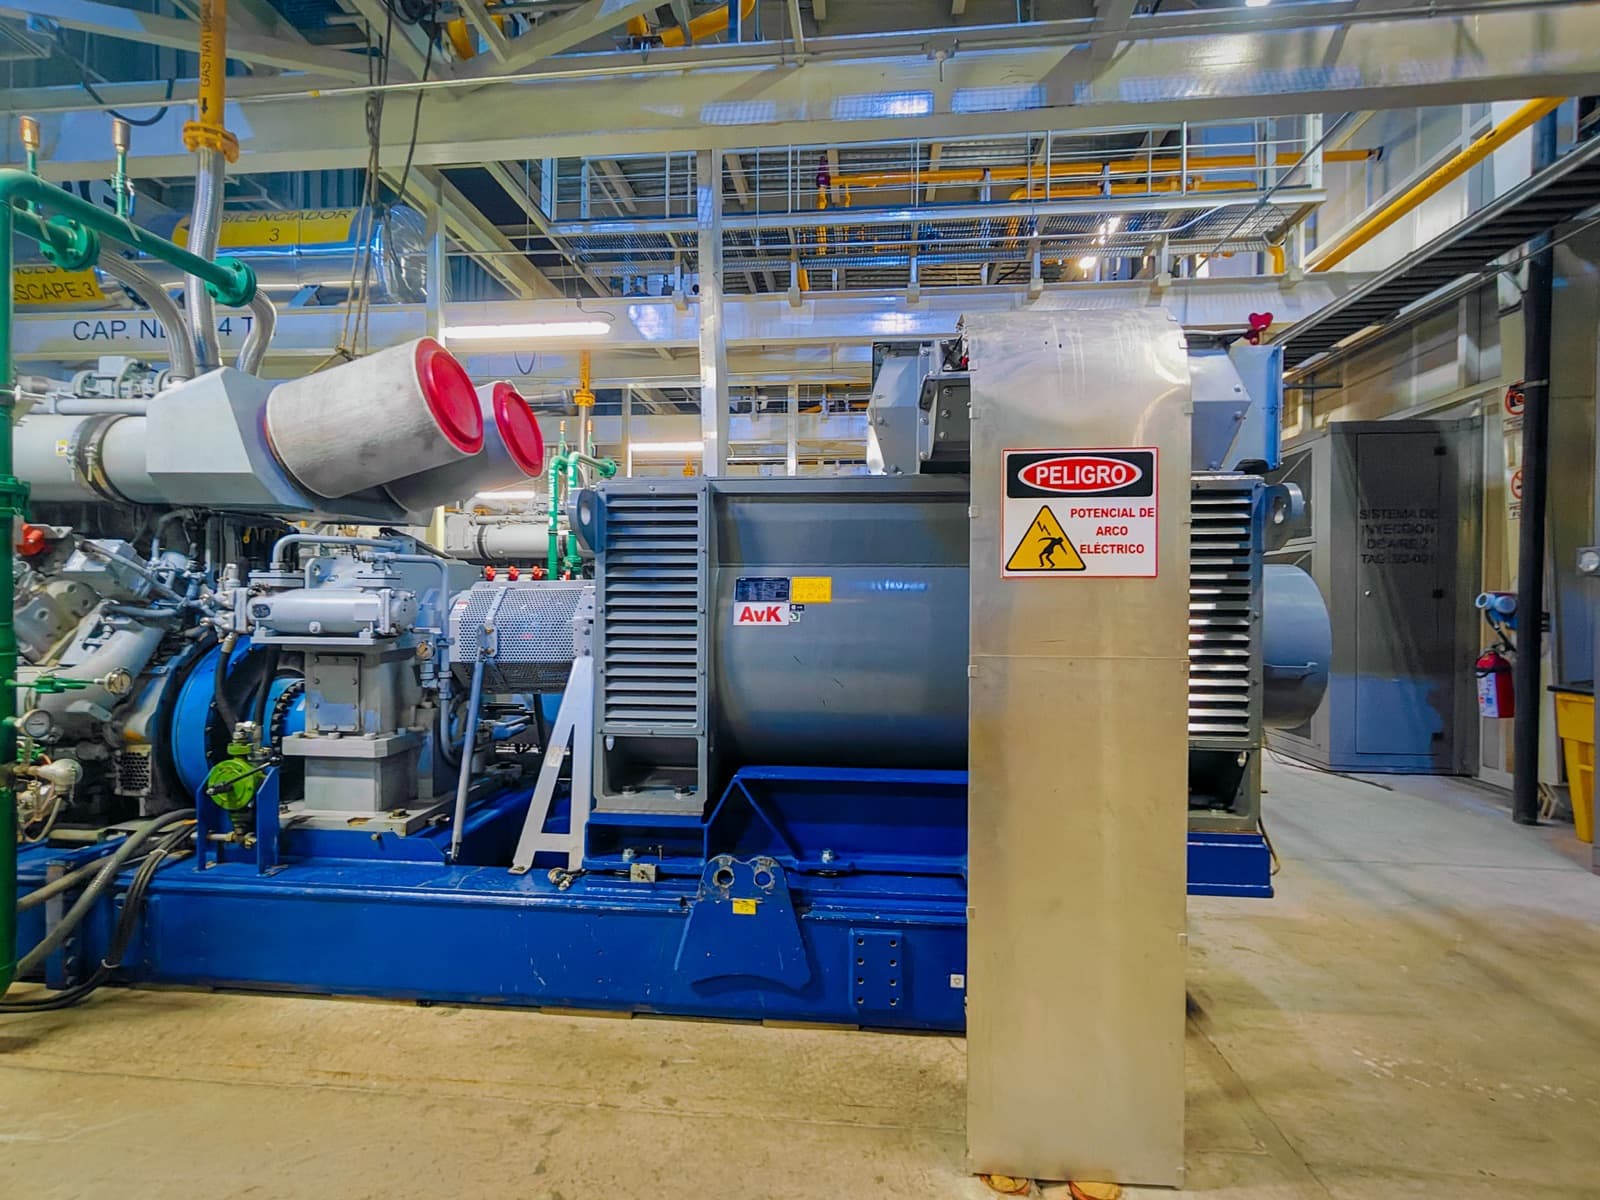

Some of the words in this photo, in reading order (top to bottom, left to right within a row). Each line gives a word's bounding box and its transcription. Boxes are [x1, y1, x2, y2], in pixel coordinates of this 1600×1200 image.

[201, 61, 212, 88] GAS
[222, 209, 350, 225] SILENCIADOR
[269, 228, 280, 243] 3
[14, 281, 81, 300] SCAPE
[82, 281, 96, 297] 3
[73, 320, 131, 341] CAP.
[1035, 465, 1127, 485] PELIGRO
[1070, 508, 1136, 518] POTENCIAL
[1139, 507, 1155, 518] DE
[1096, 526, 1128, 536] ARCO
[1080, 542, 1145, 554] ELÉCTRICO
[739, 605, 782, 623] AvK
